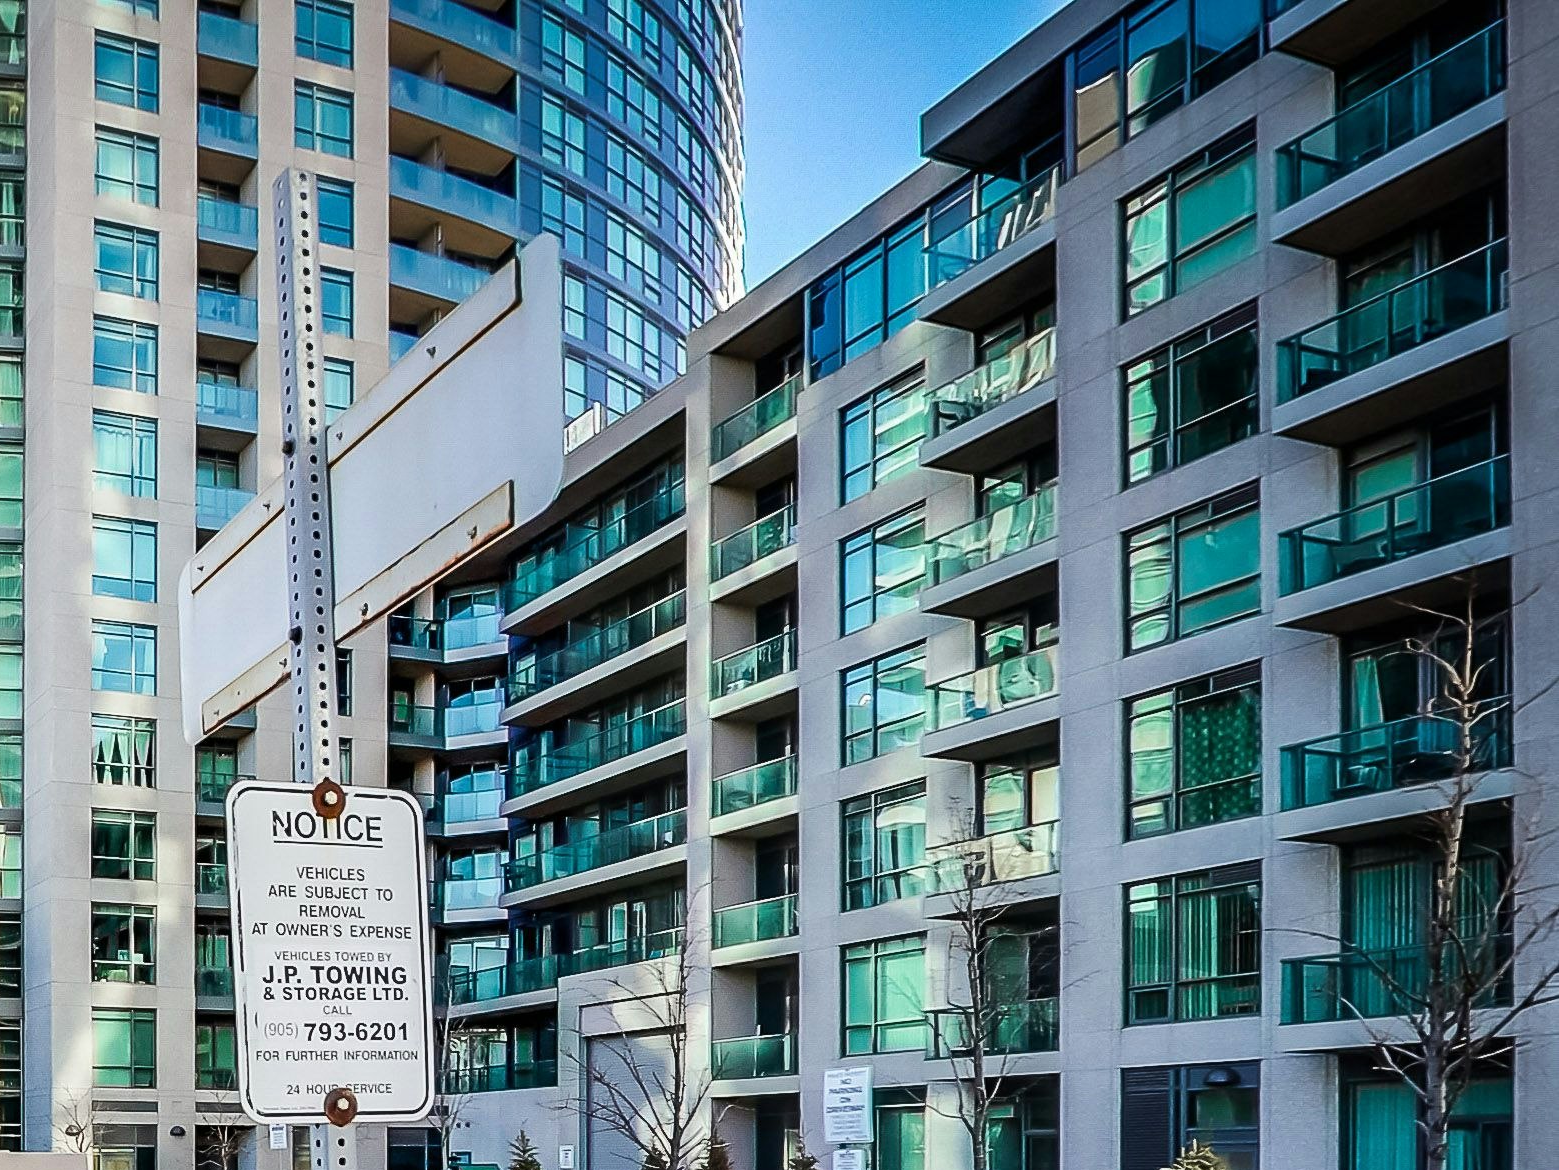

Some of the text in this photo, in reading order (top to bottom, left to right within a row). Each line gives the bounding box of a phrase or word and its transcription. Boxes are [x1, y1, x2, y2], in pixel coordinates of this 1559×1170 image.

[272, 810, 383, 842] NOTICE
[296, 866, 365, 881] VEHICLES
[268, 884, 393, 902] ARE SUBJECT TO
[299, 904, 365, 919] REMOVAL
[252, 922, 412, 940] AT OWNER'S EXPENSE
[274, 950, 392, 962] VEHICLES TOWED BY
[262, 965, 407, 985] J.P. TOWING
[263, 986, 409, 1001] & STORAGE LTD.
[323, 1005, 353, 1015] CALL
[264, 1022, 408, 1042] (905) 793-6201
[256, 1050, 419, 1062] FOR FURTHER INFORMATION
[286, 1084, 300, 1095] 24
